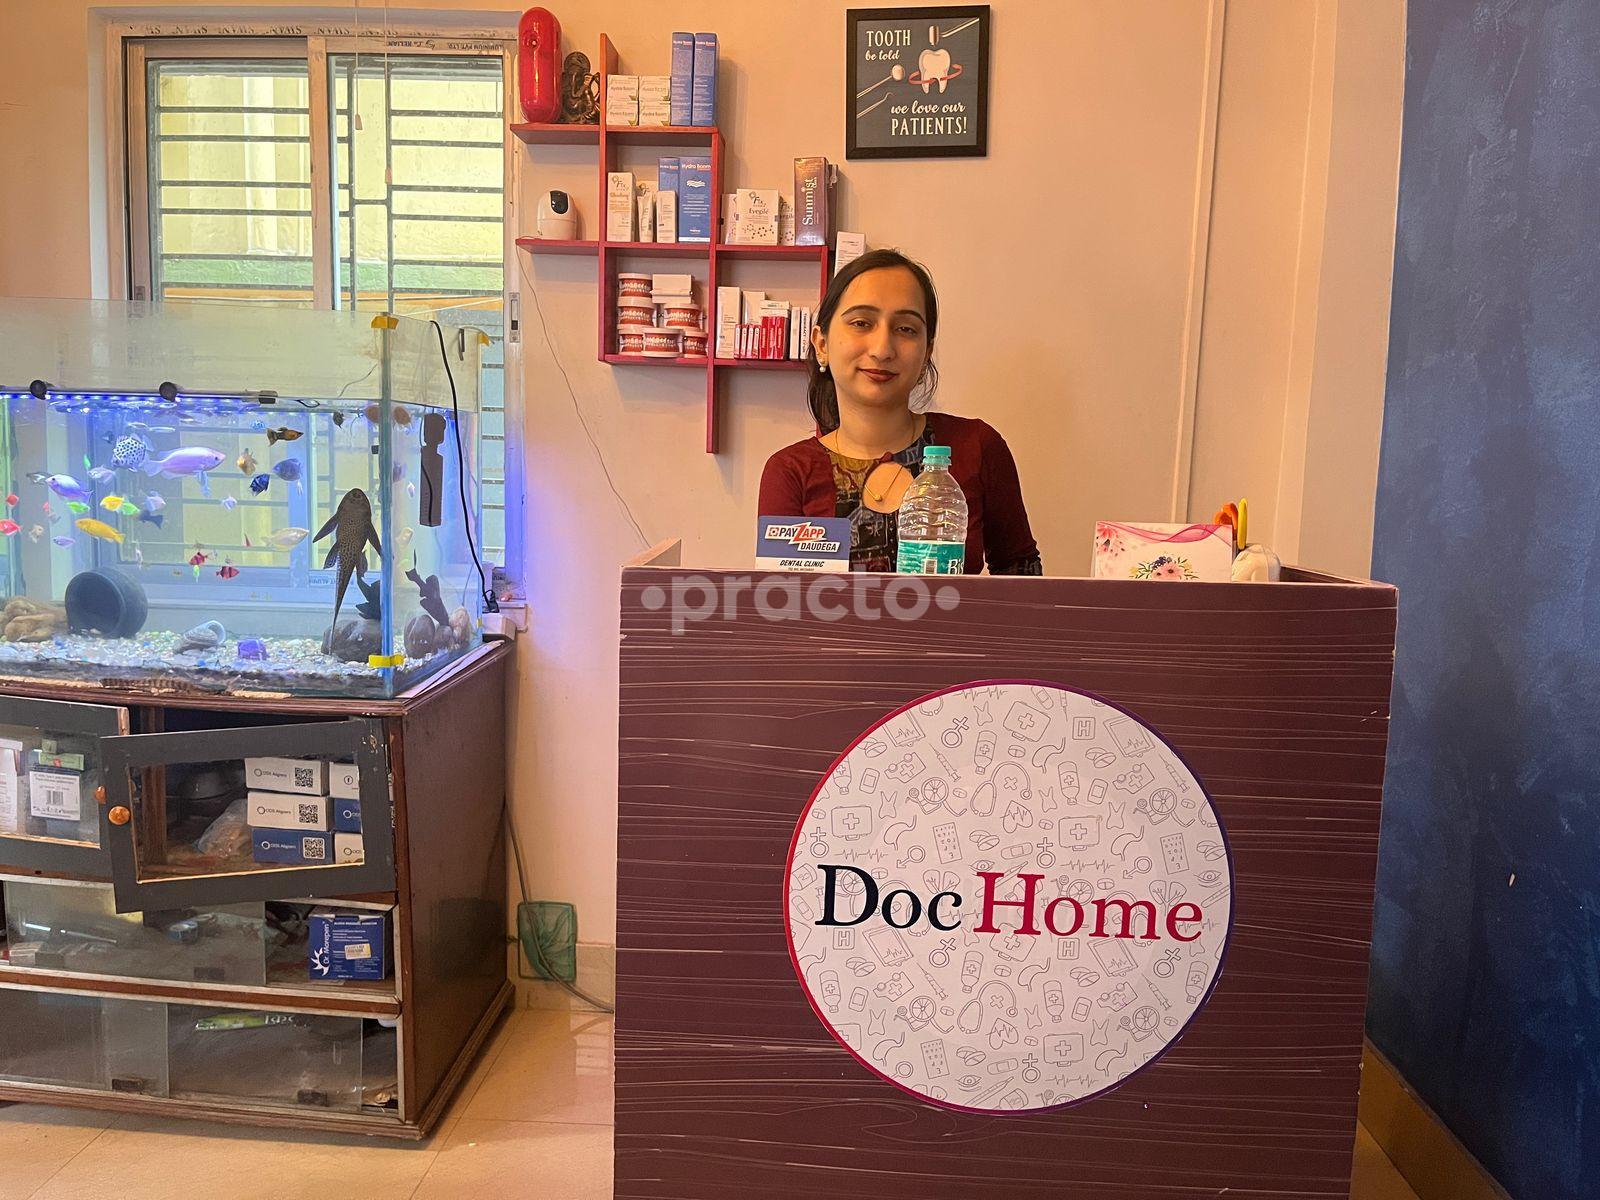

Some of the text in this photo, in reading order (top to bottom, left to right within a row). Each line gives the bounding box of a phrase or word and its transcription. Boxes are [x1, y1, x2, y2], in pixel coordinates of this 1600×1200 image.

[866, 29, 911, 47] TOOTH
[865, 49, 900, 61] be told
[891, 100, 966, 114] we love our
[891, 117, 967, 136] PATIENTS!
[801, 178, 814, 226] Sunmist
[801, 542, 837, 551] DAUDEGA
[804, 560, 825, 568] CLINIC
[815, 864, 1202, 942] Doc Home
[323, 923, 331, 954] Morepen
